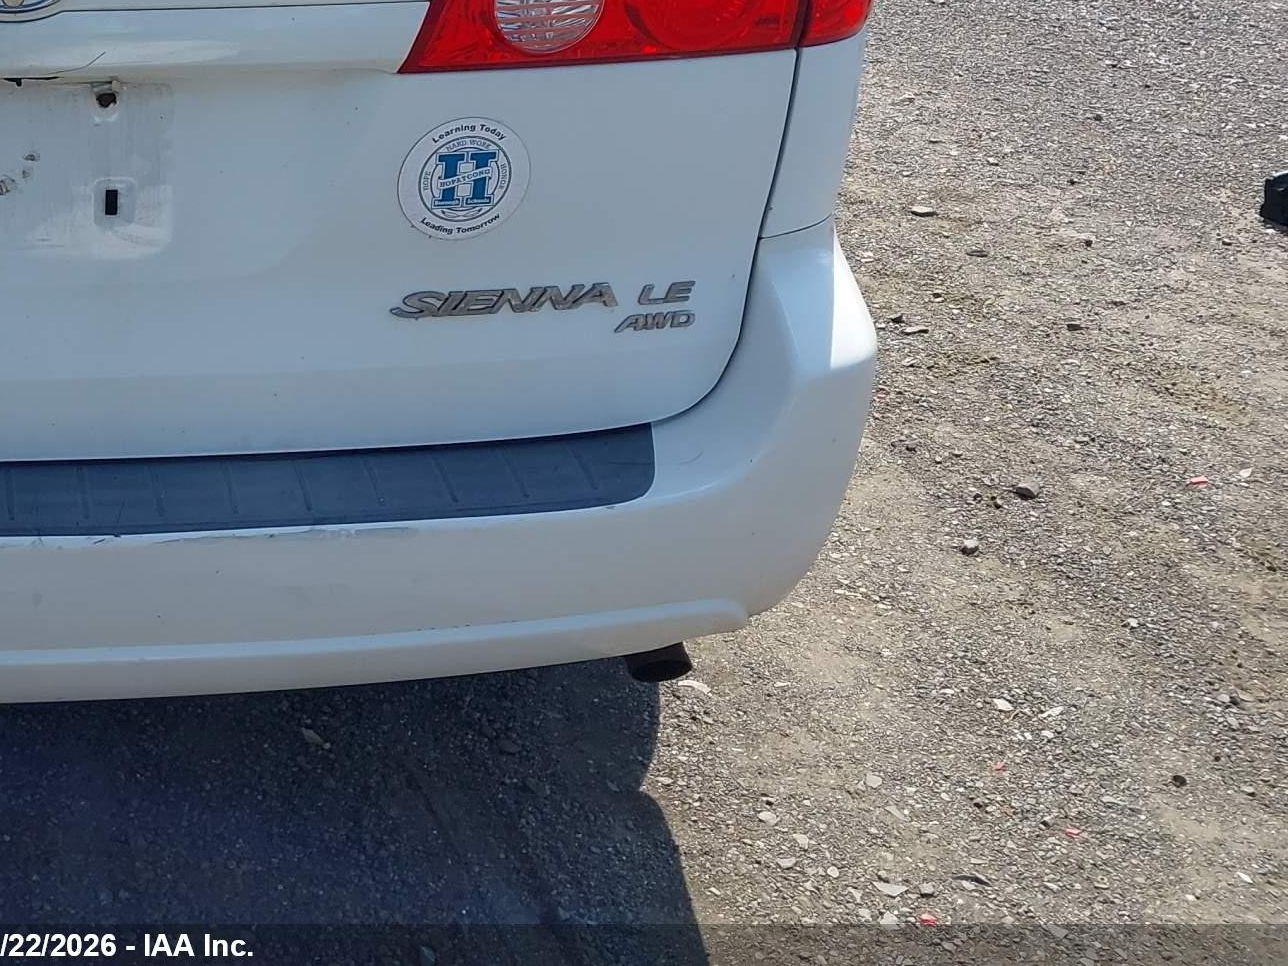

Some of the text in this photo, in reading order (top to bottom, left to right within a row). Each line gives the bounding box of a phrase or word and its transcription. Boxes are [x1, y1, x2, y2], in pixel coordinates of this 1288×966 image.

[432, 124, 507, 144] Learning Today
[420, 213, 500, 235] Leading Tomorrow
[390, 281, 696, 320] SIENNA LE
[614, 310, 696, 333] AWD
